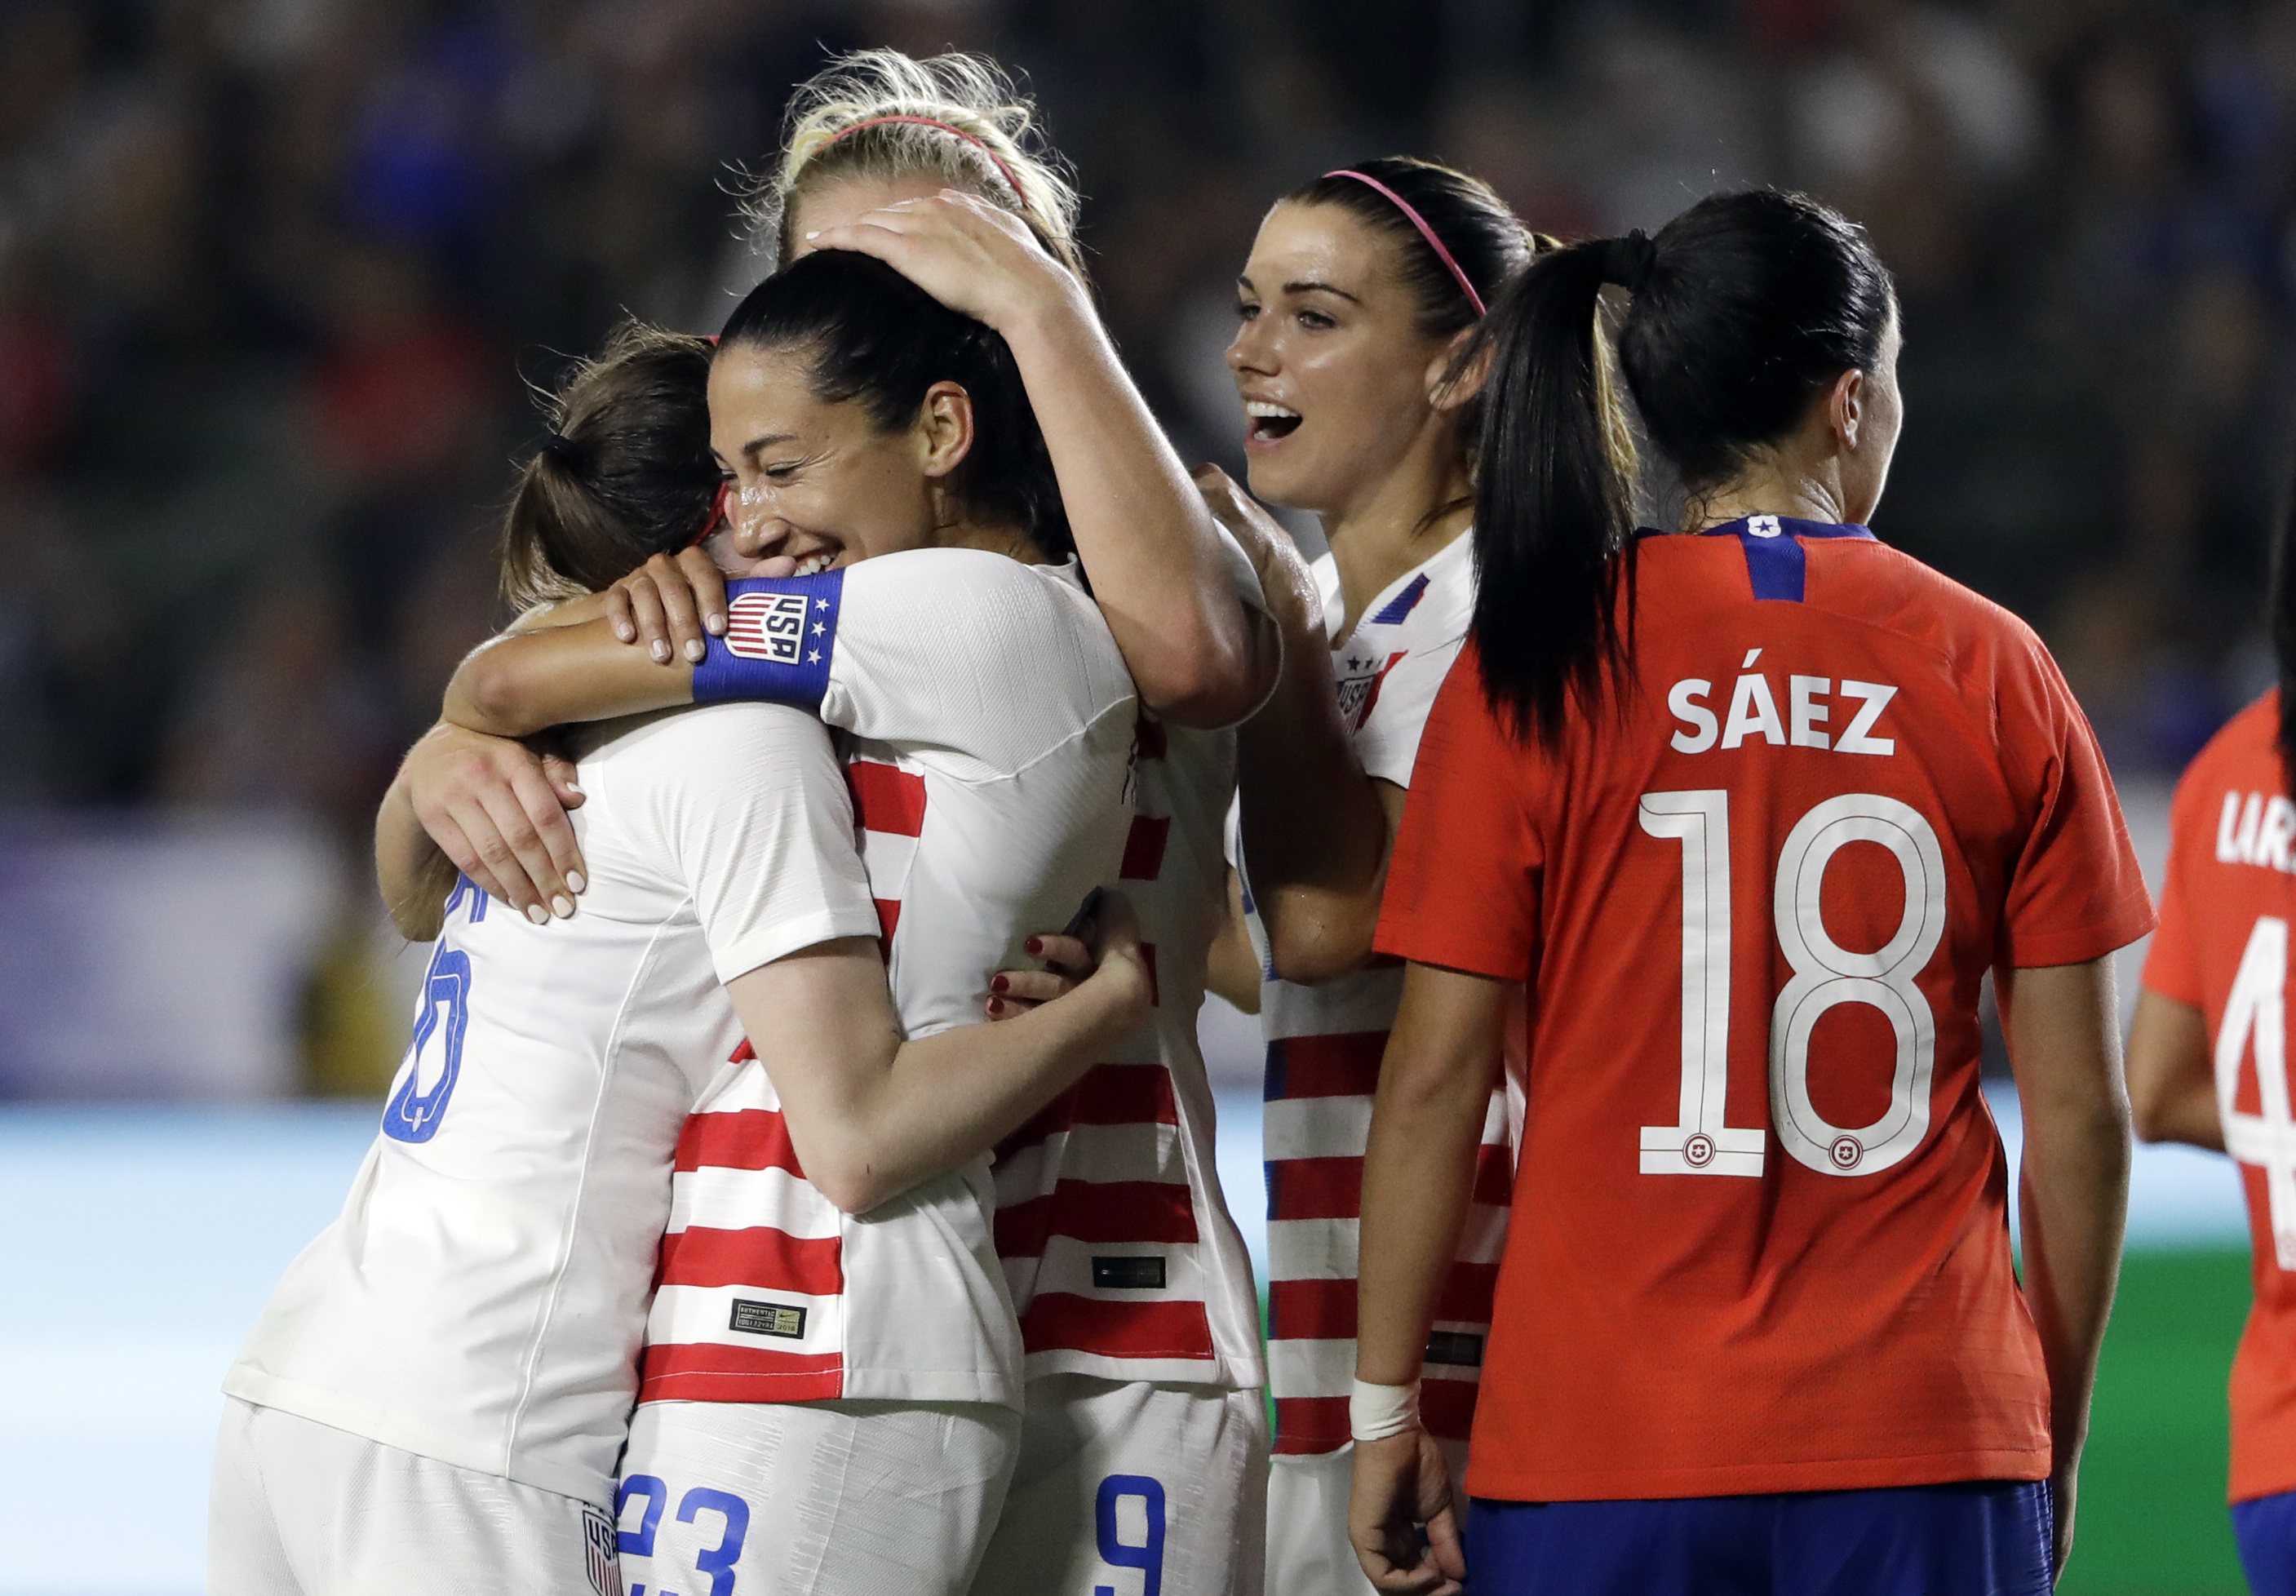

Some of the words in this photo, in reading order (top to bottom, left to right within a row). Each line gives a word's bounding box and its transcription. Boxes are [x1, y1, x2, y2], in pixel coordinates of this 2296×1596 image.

[766, 598, 803, 658] USA
[1667, 647, 1899, 756] SÁEZ
[2215, 790, 2296, 875] LAR
[1638, 789, 1947, 1177] 18
[2214, 915, 2296, 1271] 4
[615, 1474, 750, 1596] 23
[1096, 1474, 1165, 1596] 9
